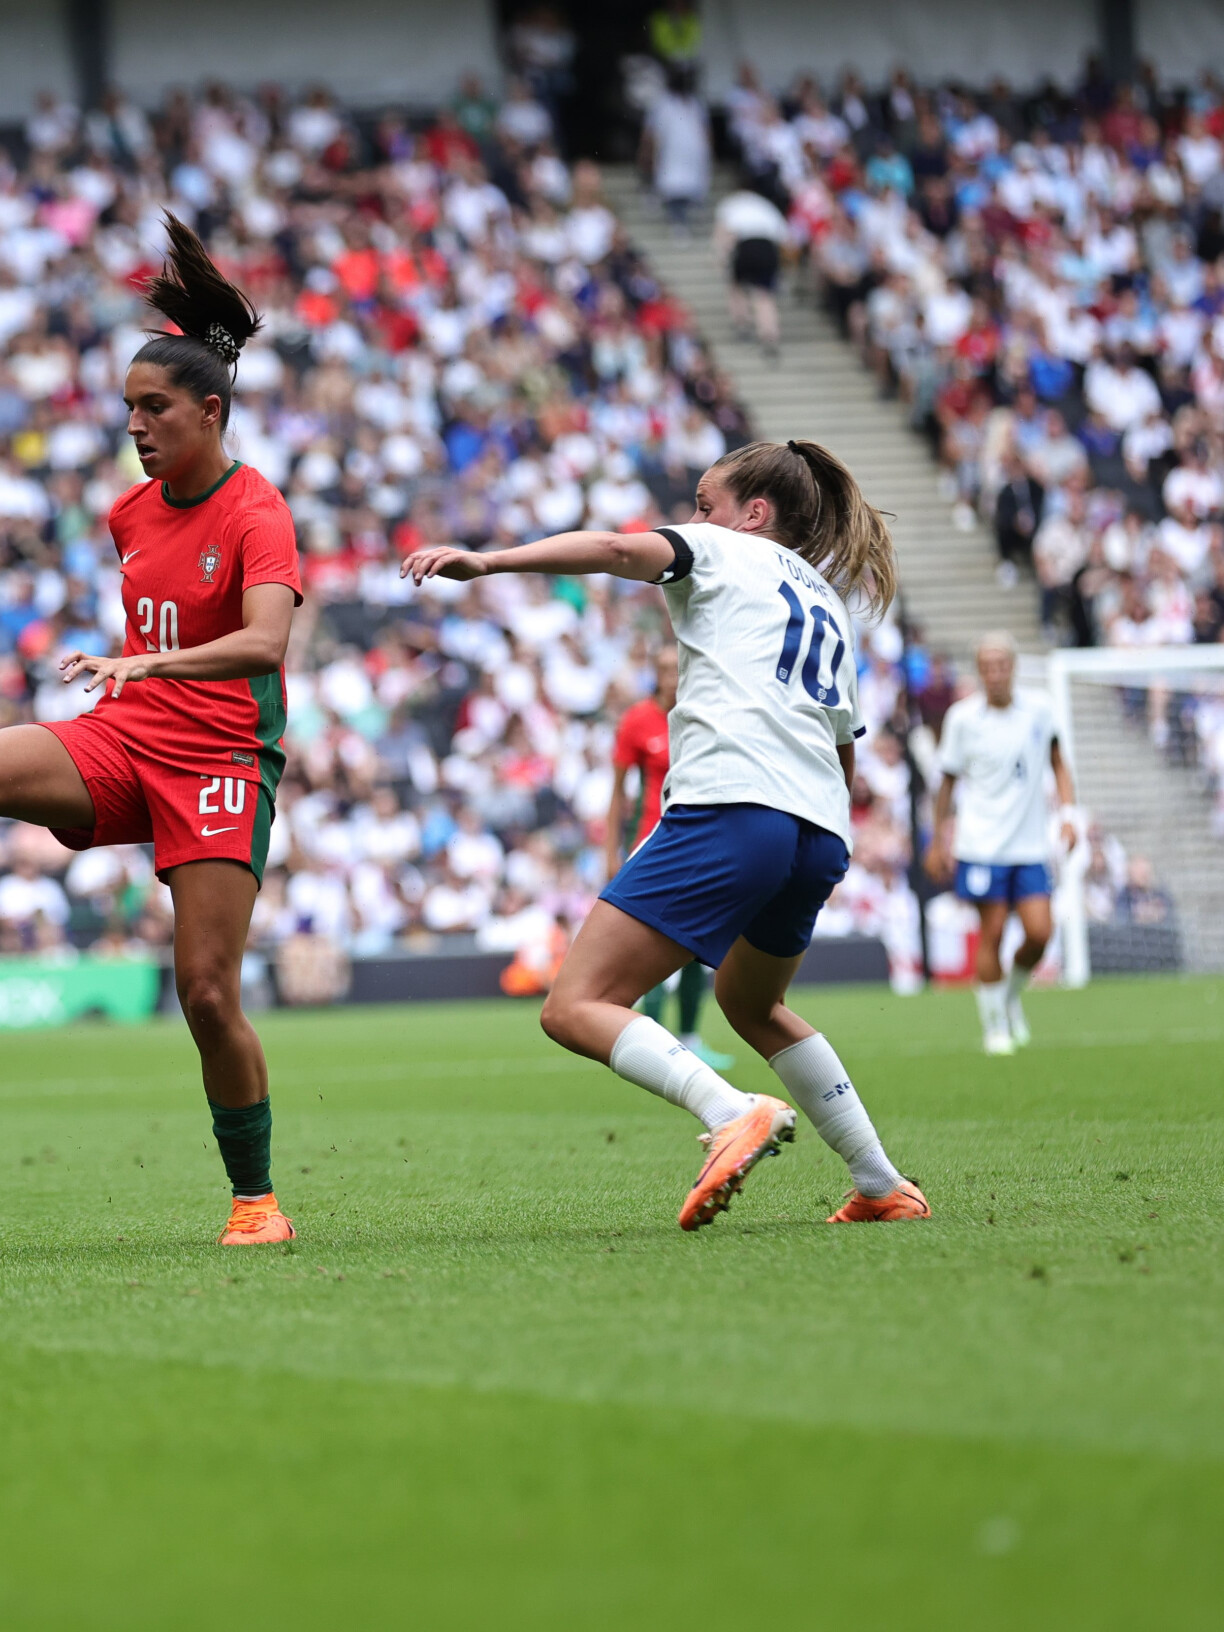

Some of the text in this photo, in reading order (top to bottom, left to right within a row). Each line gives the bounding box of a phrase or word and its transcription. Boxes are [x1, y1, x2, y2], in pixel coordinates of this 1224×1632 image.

[137, 596, 180, 653] 20
[776, 580, 845, 707] 10
[198, 774, 246, 815] 20
